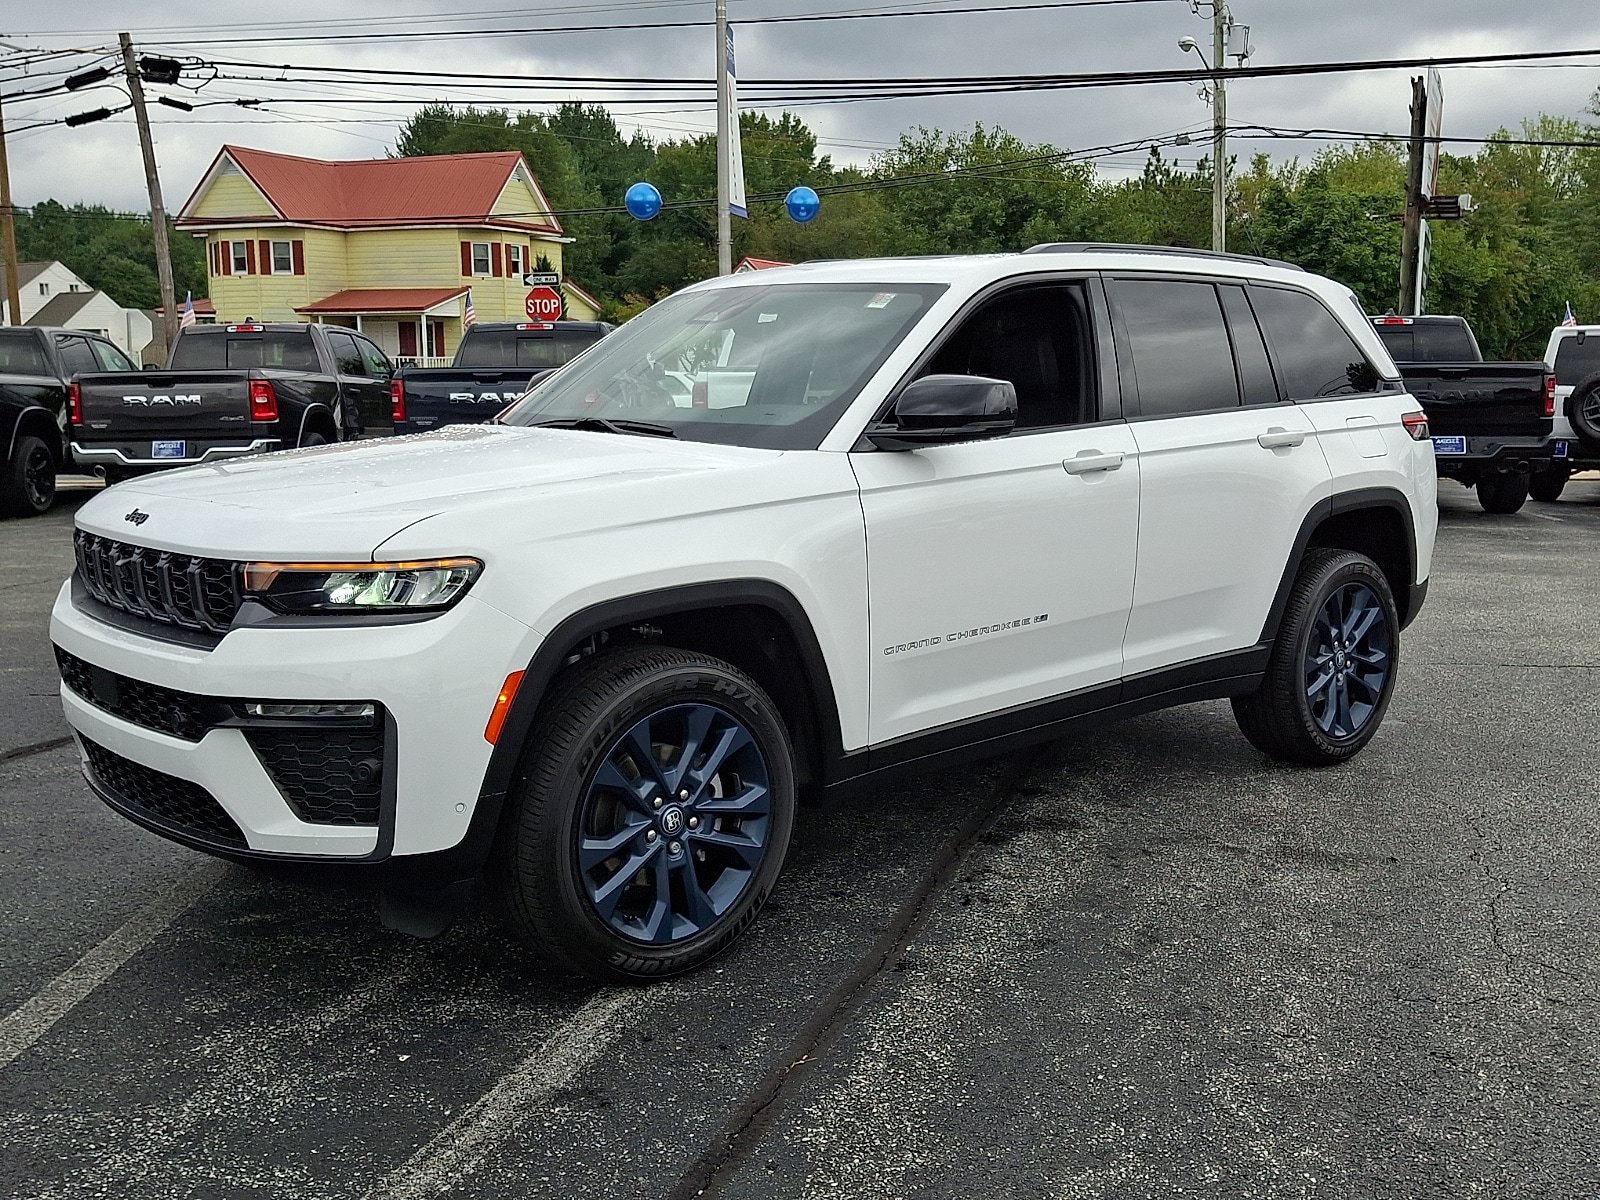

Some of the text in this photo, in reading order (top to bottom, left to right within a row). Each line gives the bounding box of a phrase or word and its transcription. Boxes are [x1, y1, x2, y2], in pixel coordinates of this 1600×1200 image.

[527, 299, 559, 314] STOP
[122, 395, 202, 407] RAM
[125, 508, 150, 526] Jeep
[884, 617, 1031, 656] GRAND CHEROKEE
